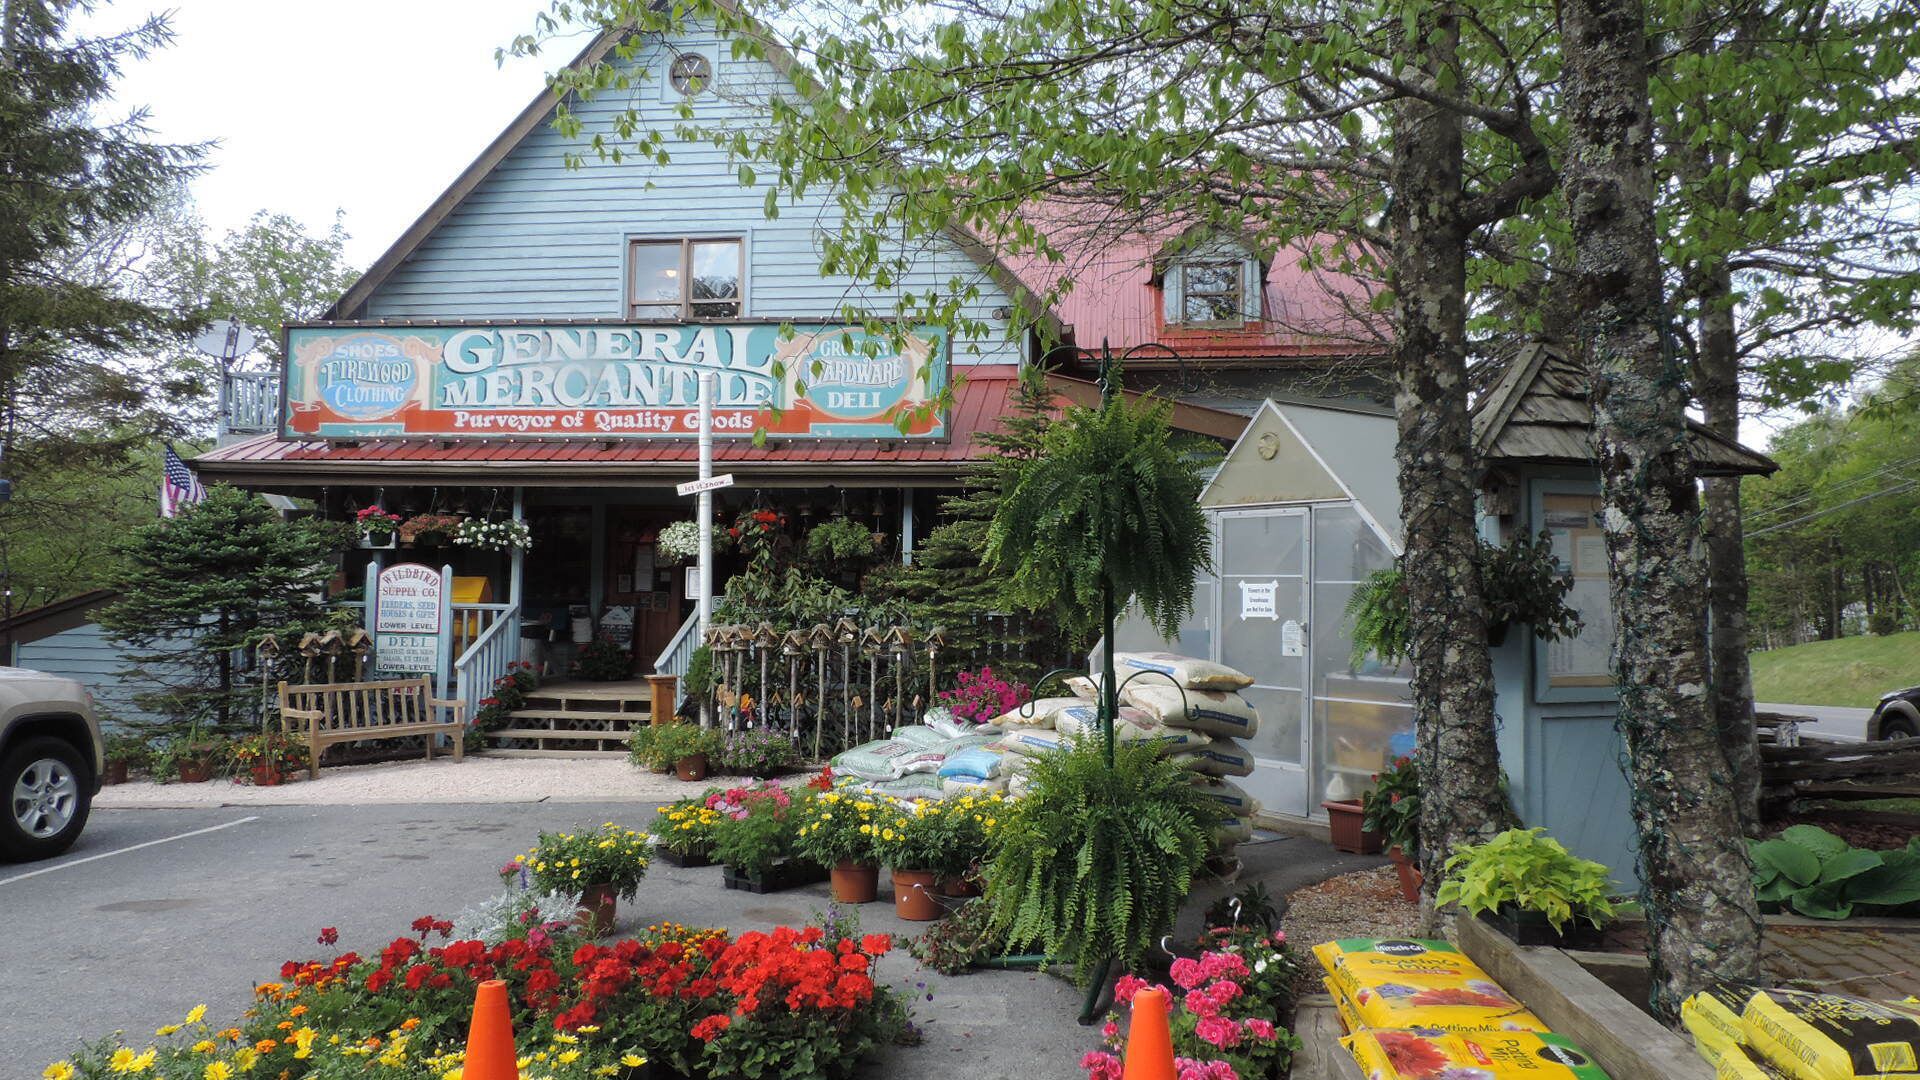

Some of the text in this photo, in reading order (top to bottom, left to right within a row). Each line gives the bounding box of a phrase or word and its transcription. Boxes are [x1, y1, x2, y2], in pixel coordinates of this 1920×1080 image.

[335, 344, 399, 358] SHOES
[443, 328, 774, 379] GENERAL
[820, 340, 894, 357] GRCY
[321, 360, 411, 389] FIREWOOD
[335, 385, 404, 407] CLOTHING
[827, 391, 881, 408] DELI
[454, 411, 753, 431] Purveyor of Quality Gods
[382, 568, 439, 587] WILDBIRD
[382, 587, 418, 597] SUPPLY
[388, 636, 427, 648] DELI
